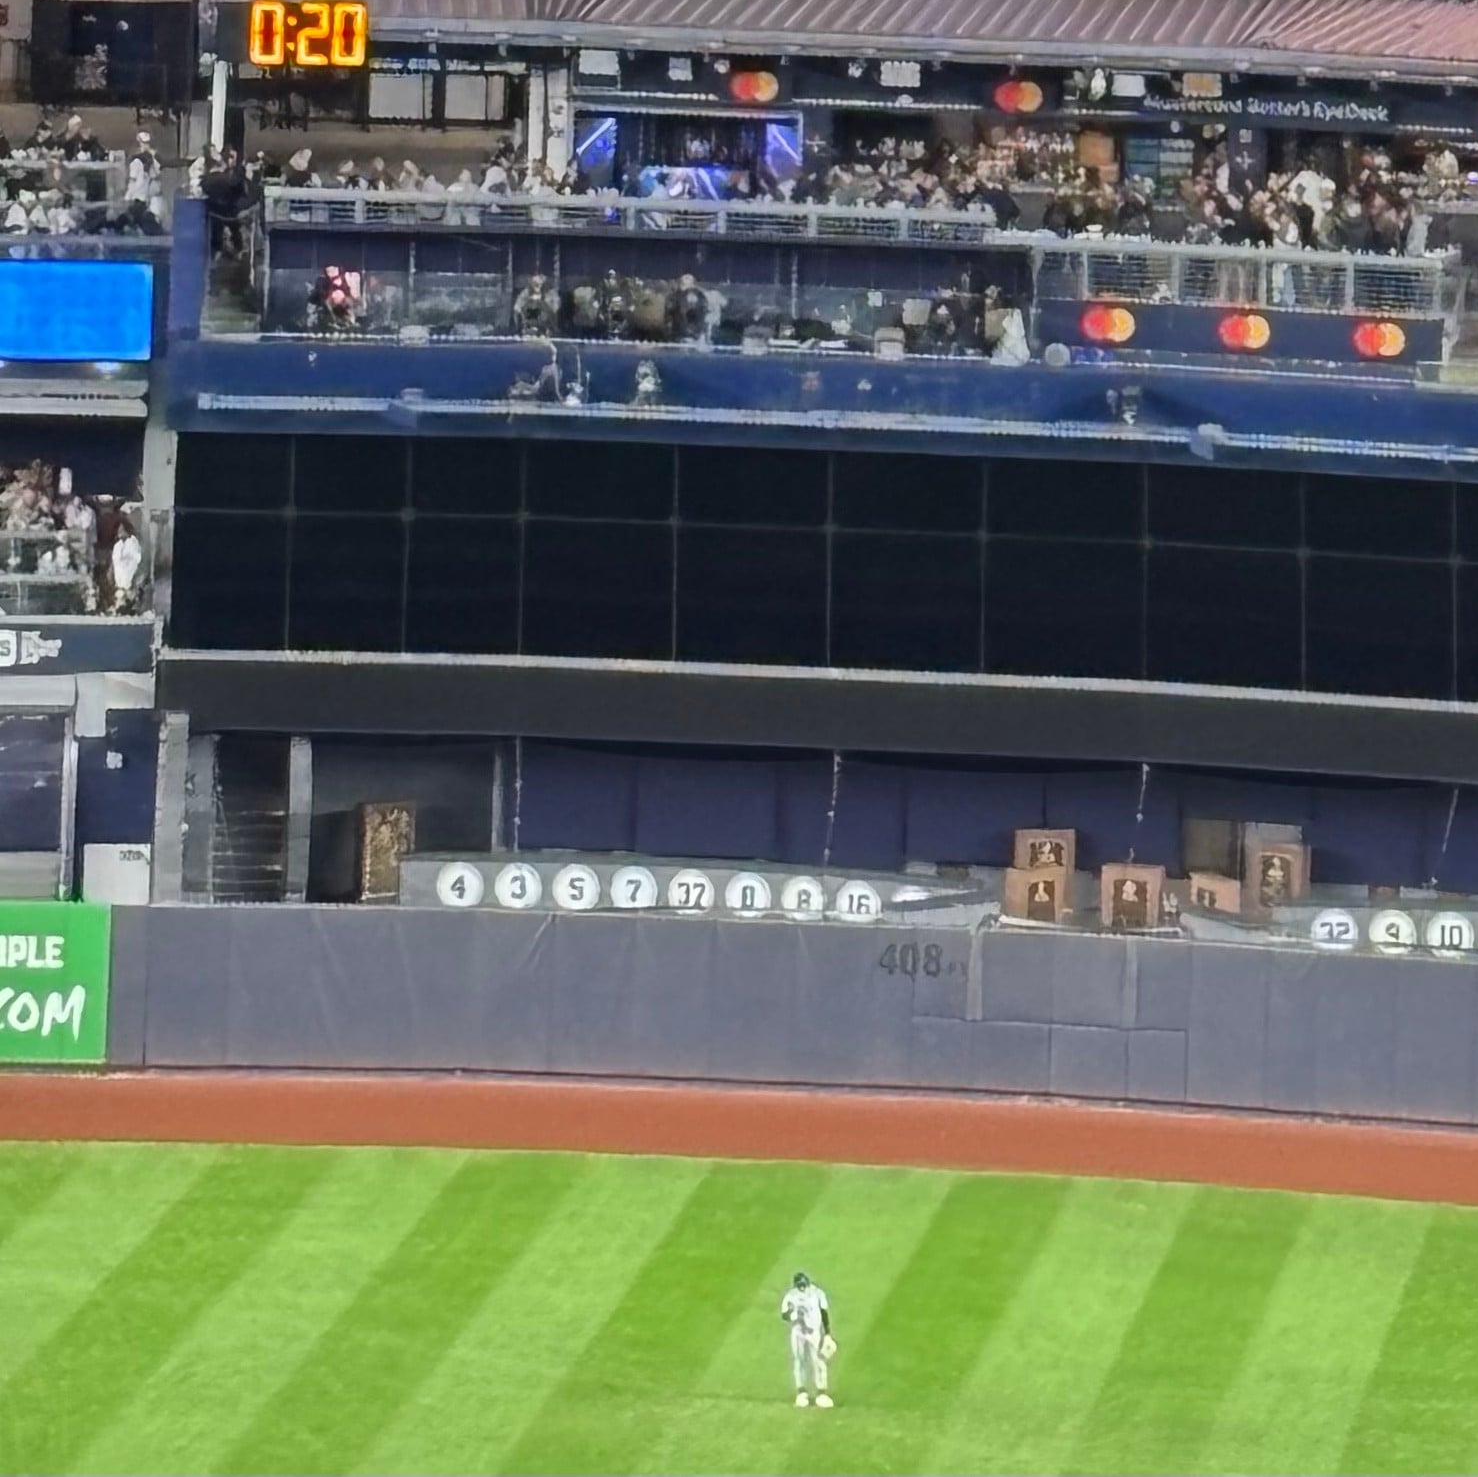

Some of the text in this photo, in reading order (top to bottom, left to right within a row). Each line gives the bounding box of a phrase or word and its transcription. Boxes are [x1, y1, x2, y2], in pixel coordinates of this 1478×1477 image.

[250, 0, 367, 66] 0:20
[510, 875, 527, 899] 3
[569, 877, 585, 901] 5
[626, 879, 642, 902] 7
[1440, 924, 1463, 948] 10
[879, 942, 943, 977] 408
